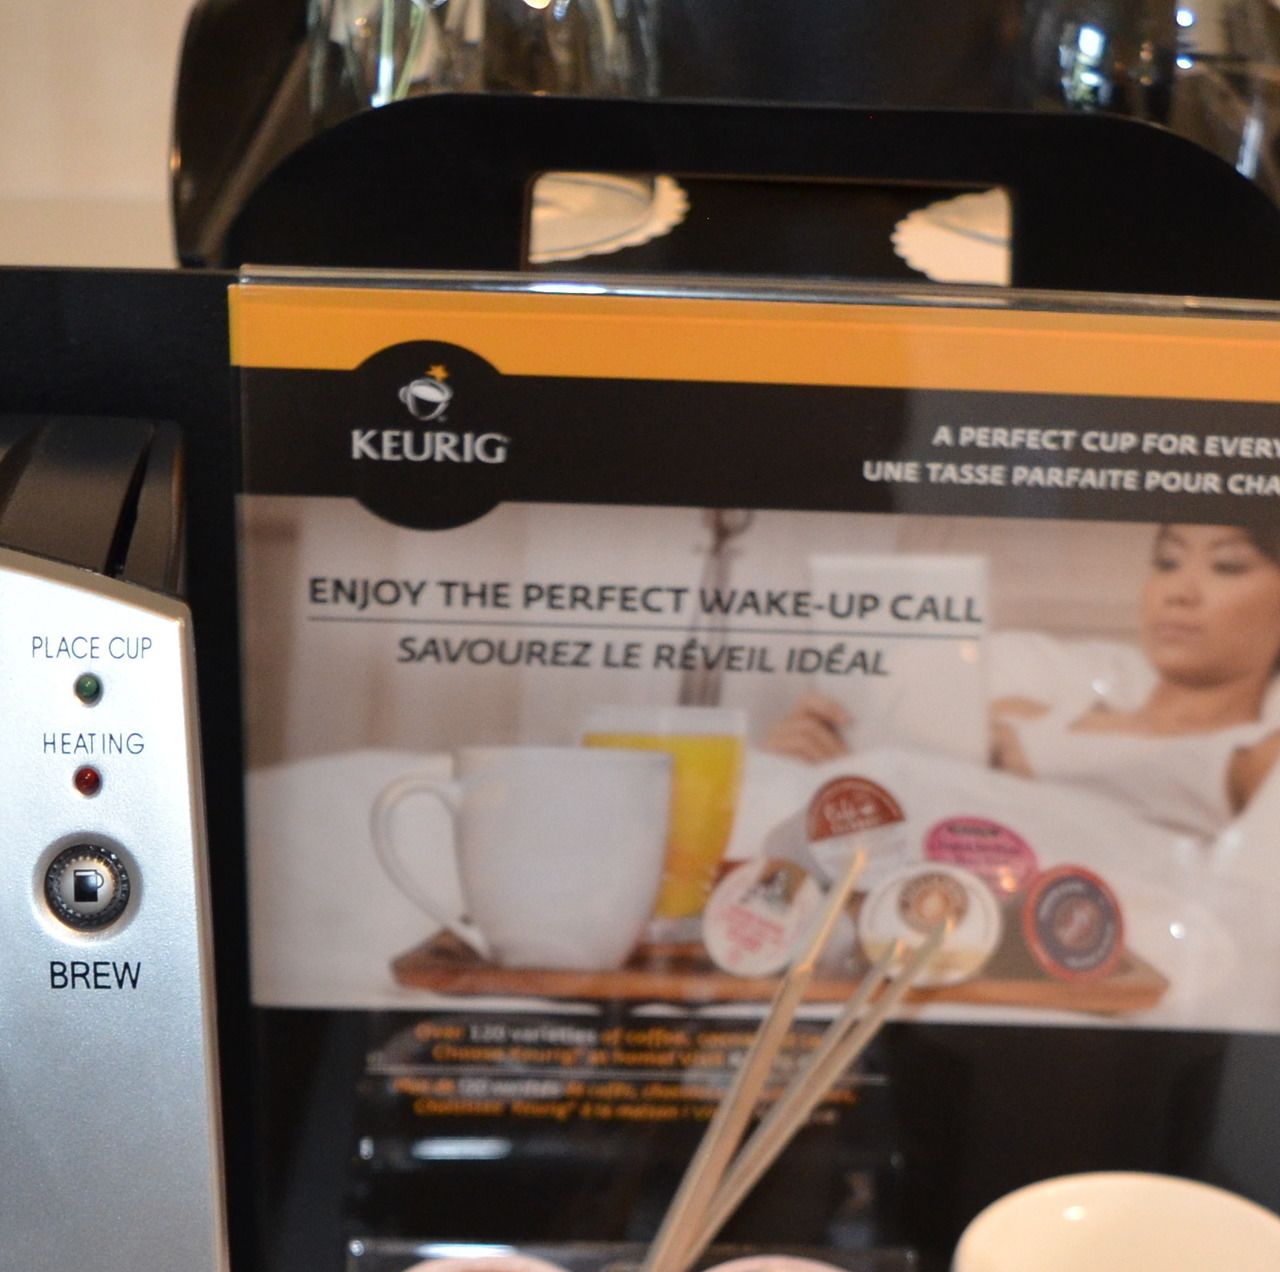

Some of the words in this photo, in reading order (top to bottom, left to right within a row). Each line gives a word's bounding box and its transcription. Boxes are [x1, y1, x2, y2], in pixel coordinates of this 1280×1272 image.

[351, 429, 509, 464] KEURIG
[932, 425, 954, 447] A
[959, 427, 1077, 452] PERFECT
[1081, 430, 1138, 454] CUP
[1142, 433, 1198, 456] FOR
[863, 460, 919, 484] UNE
[926, 462, 1007, 487] TASSE
[1012, 465, 1140, 493] PARFAITE
[1145, 470, 1220, 495] POUR
[308, 577, 425, 612] ENJOY
[426, 580, 511, 609] THE
[523, 583, 689, 615] PERFECT
[698, 588, 881, 619] WAKE-UP
[891, 594, 983, 623] CALL
[32, 636, 100, 659] PLACE
[108, 636, 152, 659] CUP
[397, 635, 592, 669] SAVOUREZ
[603, 640, 641, 669] LE
[653, 637, 775, 675] RÉVEIL
[785, 639, 891, 677] IDÉAL
[42, 733, 145, 755] HEATING
[50, 961, 141, 990] BREW
